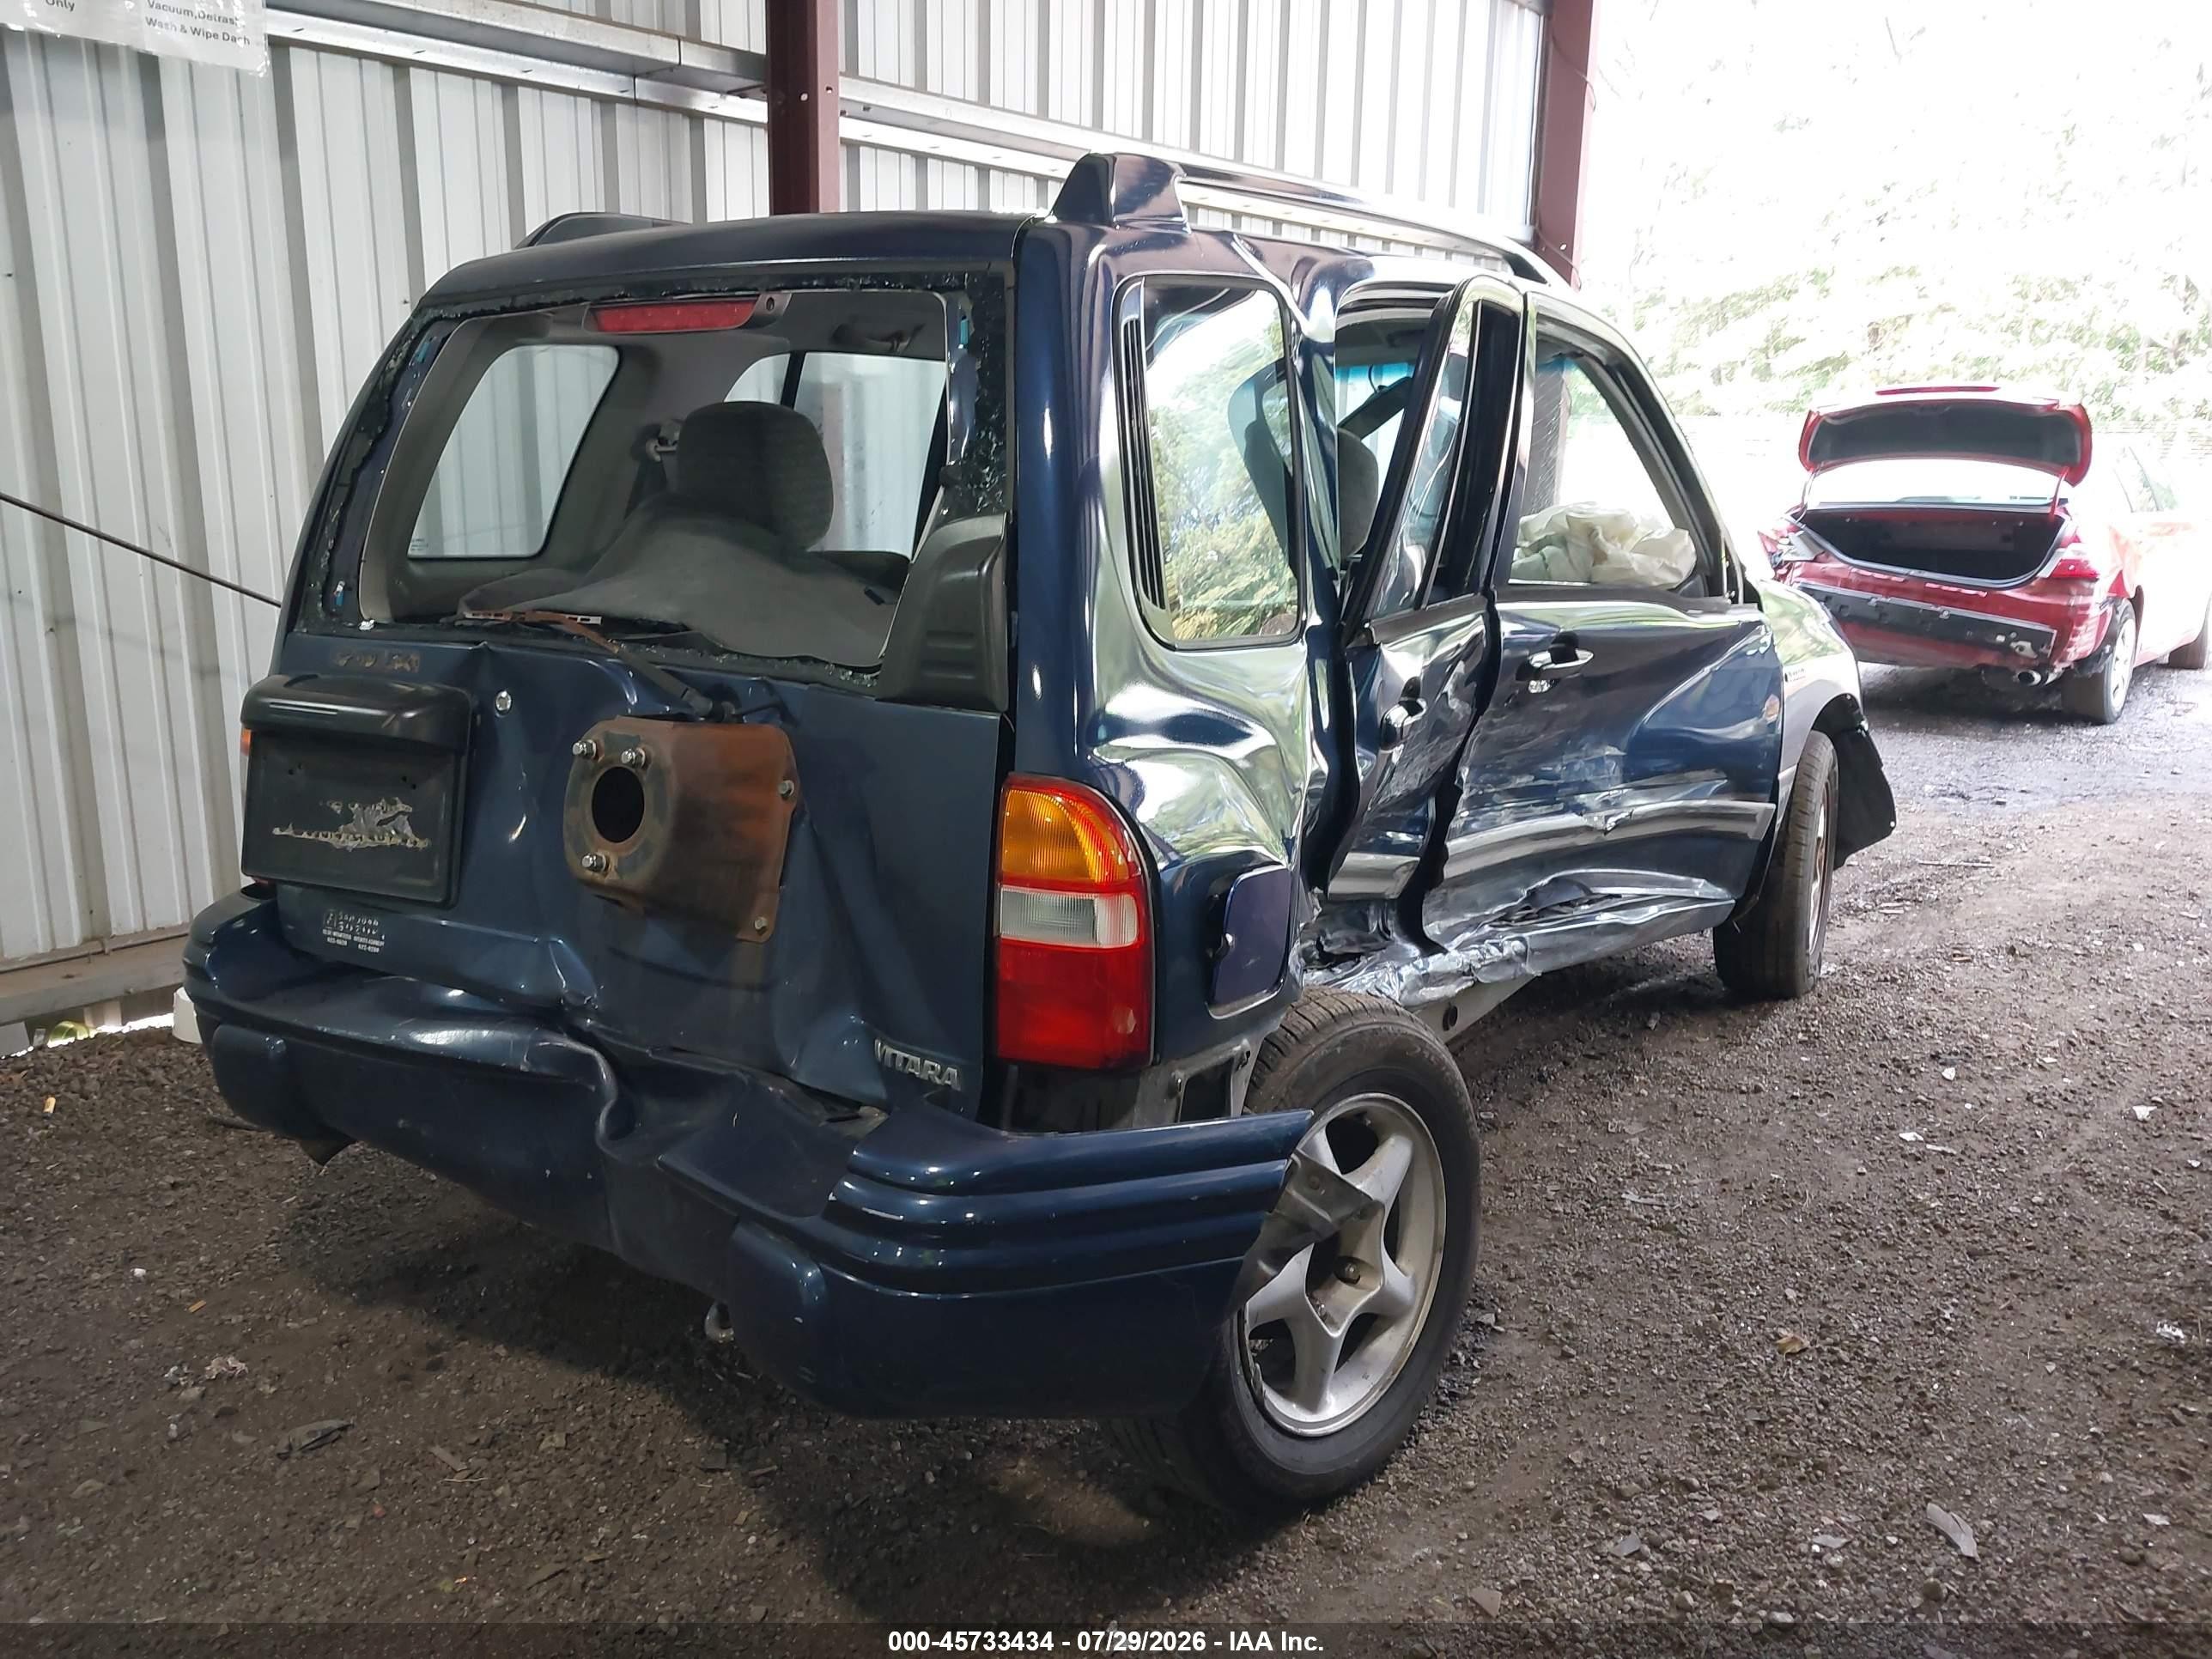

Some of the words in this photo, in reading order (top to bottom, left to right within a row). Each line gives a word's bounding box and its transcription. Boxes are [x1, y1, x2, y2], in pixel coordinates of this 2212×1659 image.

[146, 0, 245, 27] Vacuum,Detras
[144, 16, 177, 32] Wash
[179, 24, 187, 33] &
[190, 26, 219, 40] Wipe
[874, 1038, 961, 1091] VITARA
